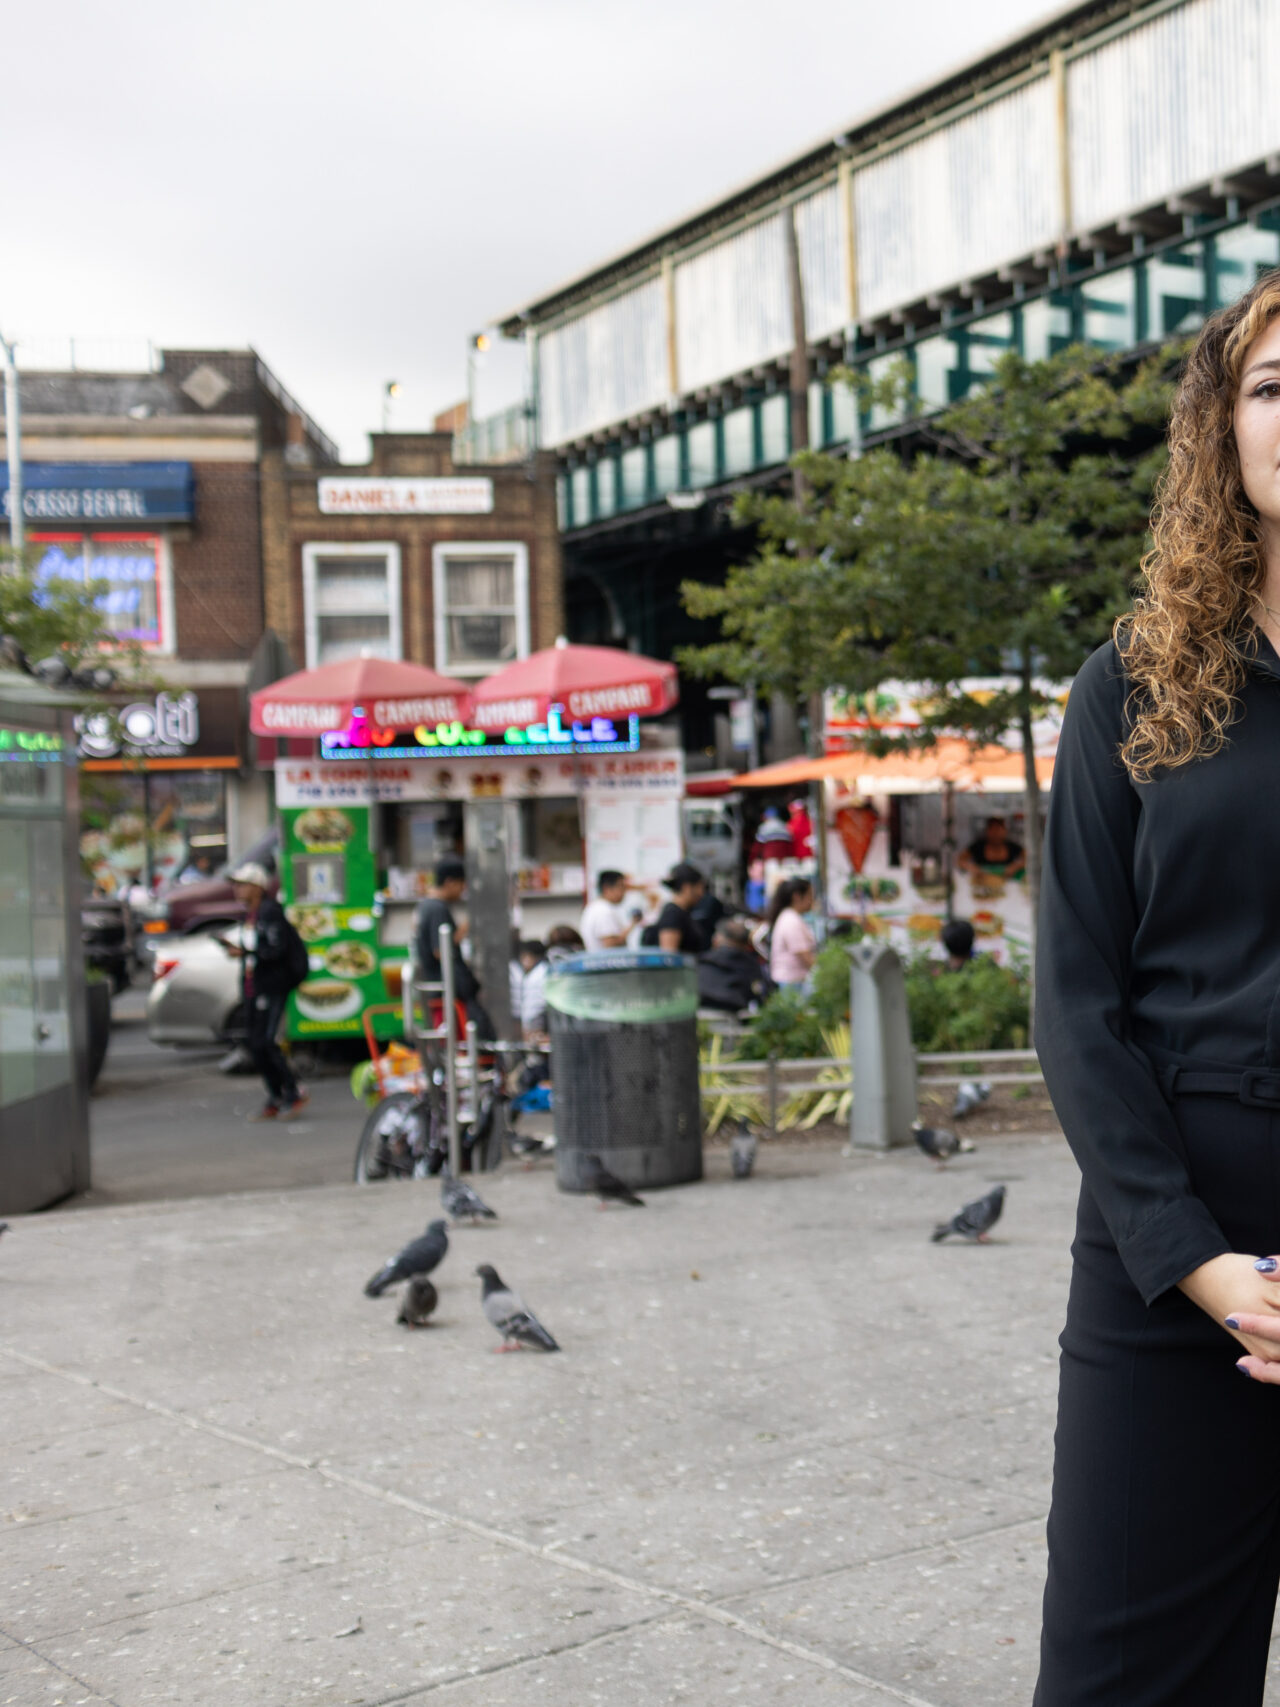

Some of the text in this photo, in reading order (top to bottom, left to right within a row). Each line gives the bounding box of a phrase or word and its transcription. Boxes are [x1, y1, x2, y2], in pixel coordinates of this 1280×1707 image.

[262, 702, 341, 729] CAMPARI
[374, 697, 459, 727] CAMPARI
[566, 684, 653, 717] CAMPARI
